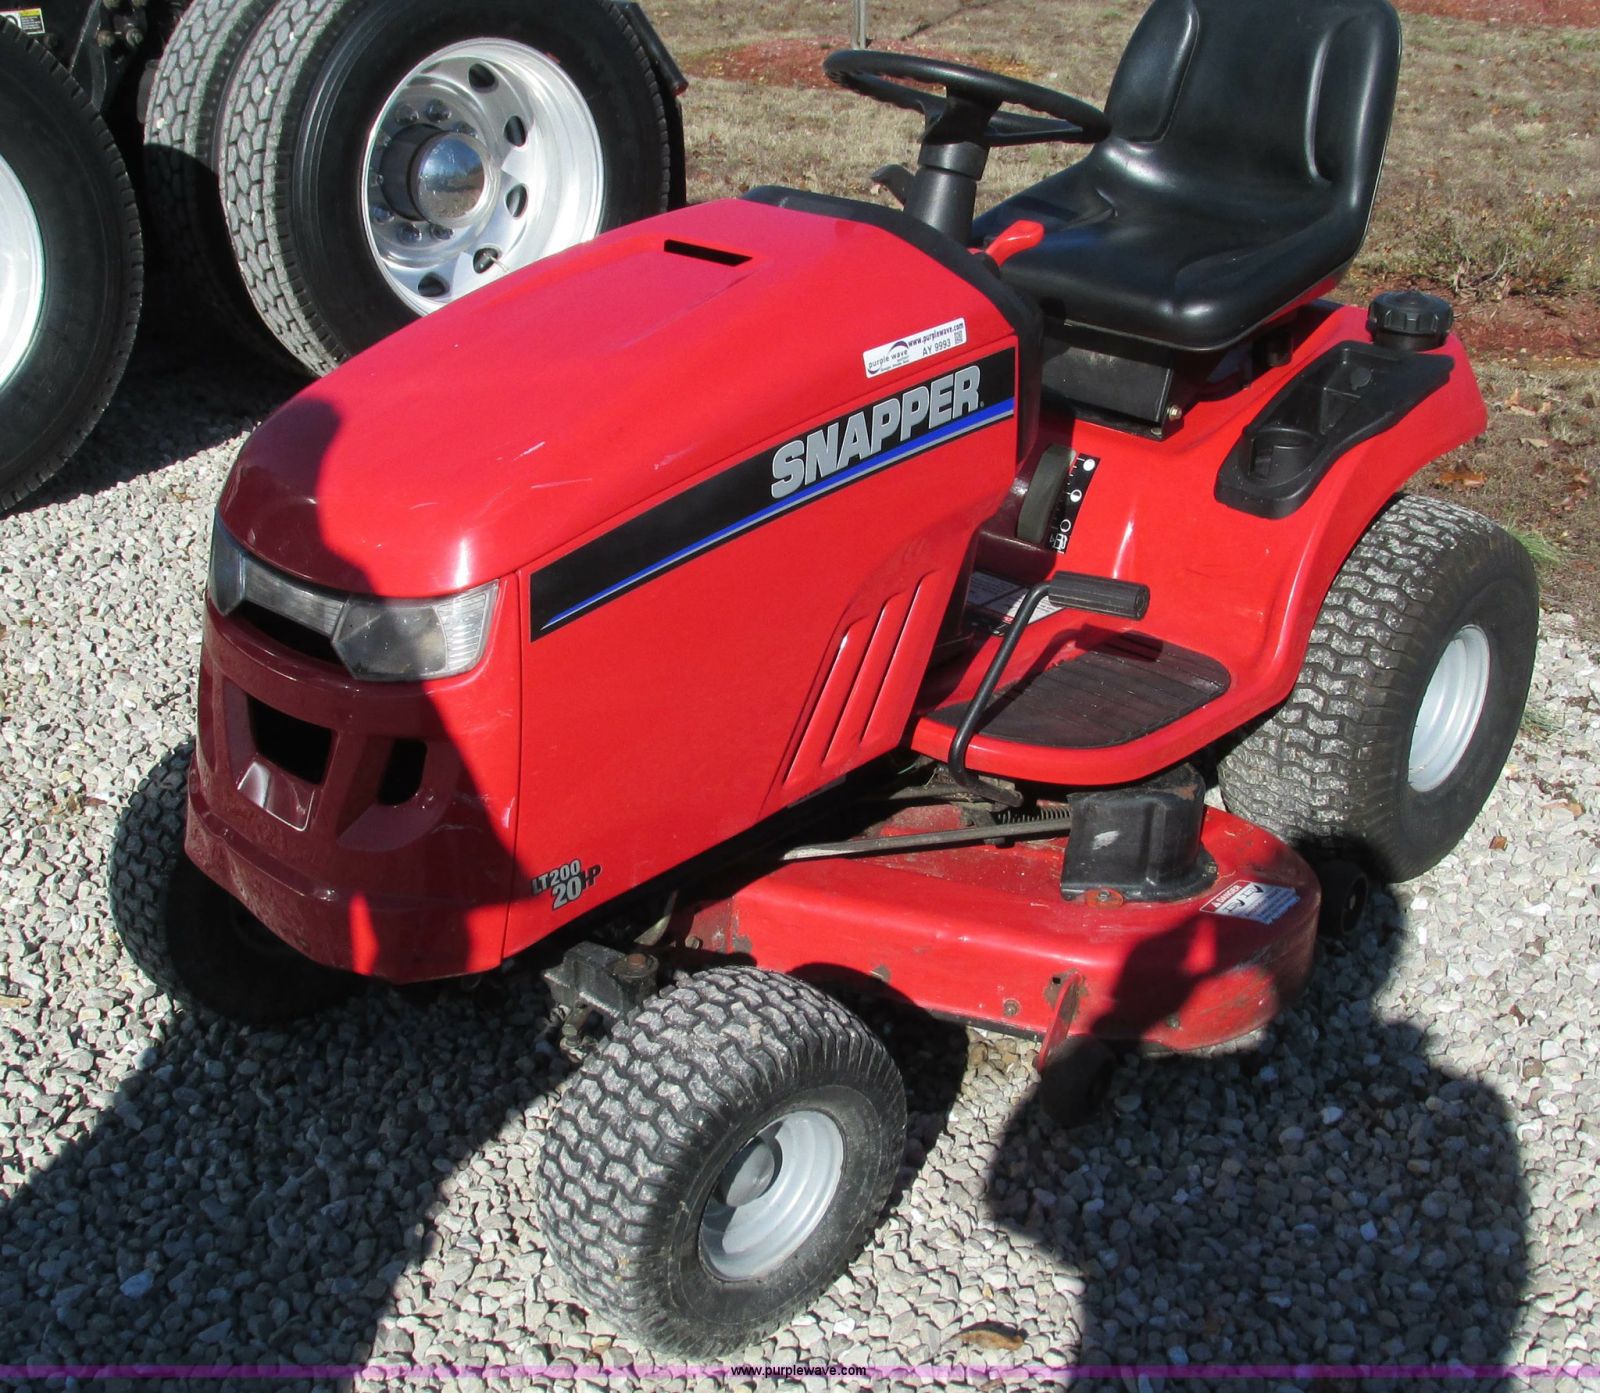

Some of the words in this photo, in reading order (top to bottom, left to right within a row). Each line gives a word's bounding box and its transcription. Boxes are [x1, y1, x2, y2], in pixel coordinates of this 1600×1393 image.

[908, 322, 964, 347] www.purplewave.com
[868, 356, 890, 370] purple
[891, 349, 908, 360] wave
[922, 347, 932, 357] AY
[934, 339, 951, 353] 9993
[771, 365, 981, 498] SNAPPER
[531, 858, 582, 896] LT200
